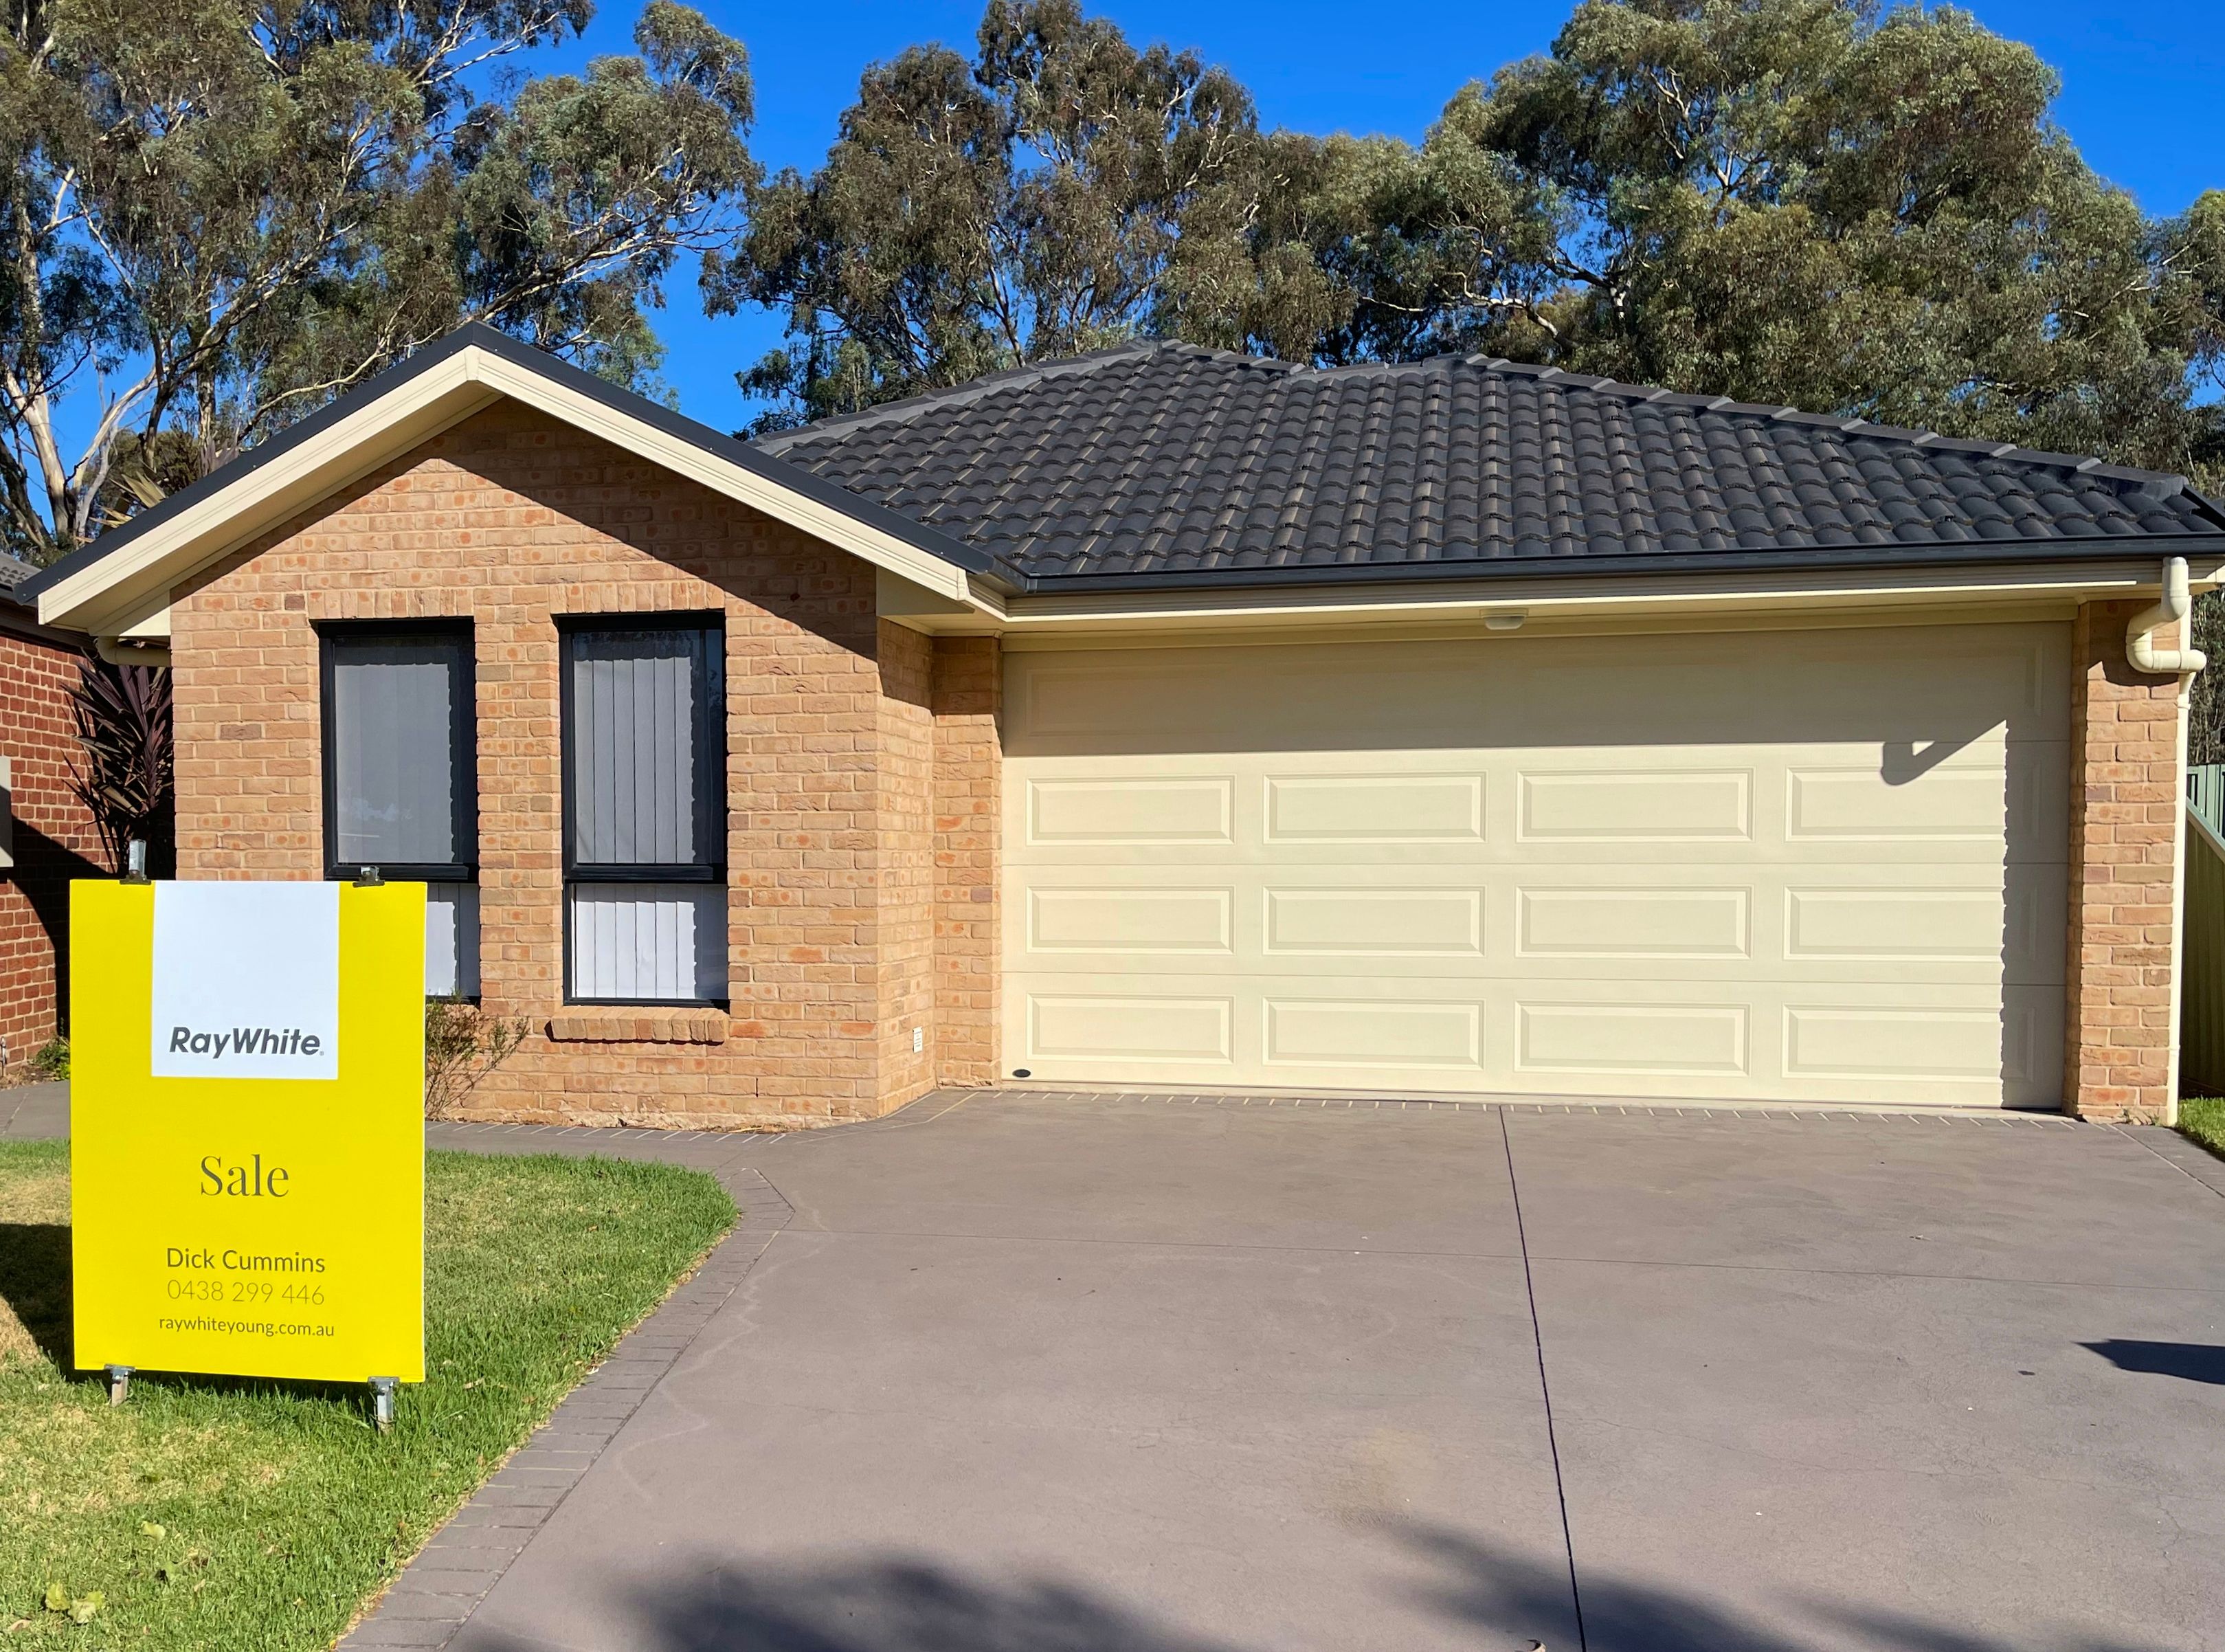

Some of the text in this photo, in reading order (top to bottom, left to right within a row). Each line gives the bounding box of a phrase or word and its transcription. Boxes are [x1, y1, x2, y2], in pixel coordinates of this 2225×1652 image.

[201, 1153, 289, 1198] Sale
[167, 1247, 326, 1273] Dick Cummins
[167, 1279, 324, 1305] 0438 299 446
[159, 1315, 335, 1337] raywhiteyoung.com.au
